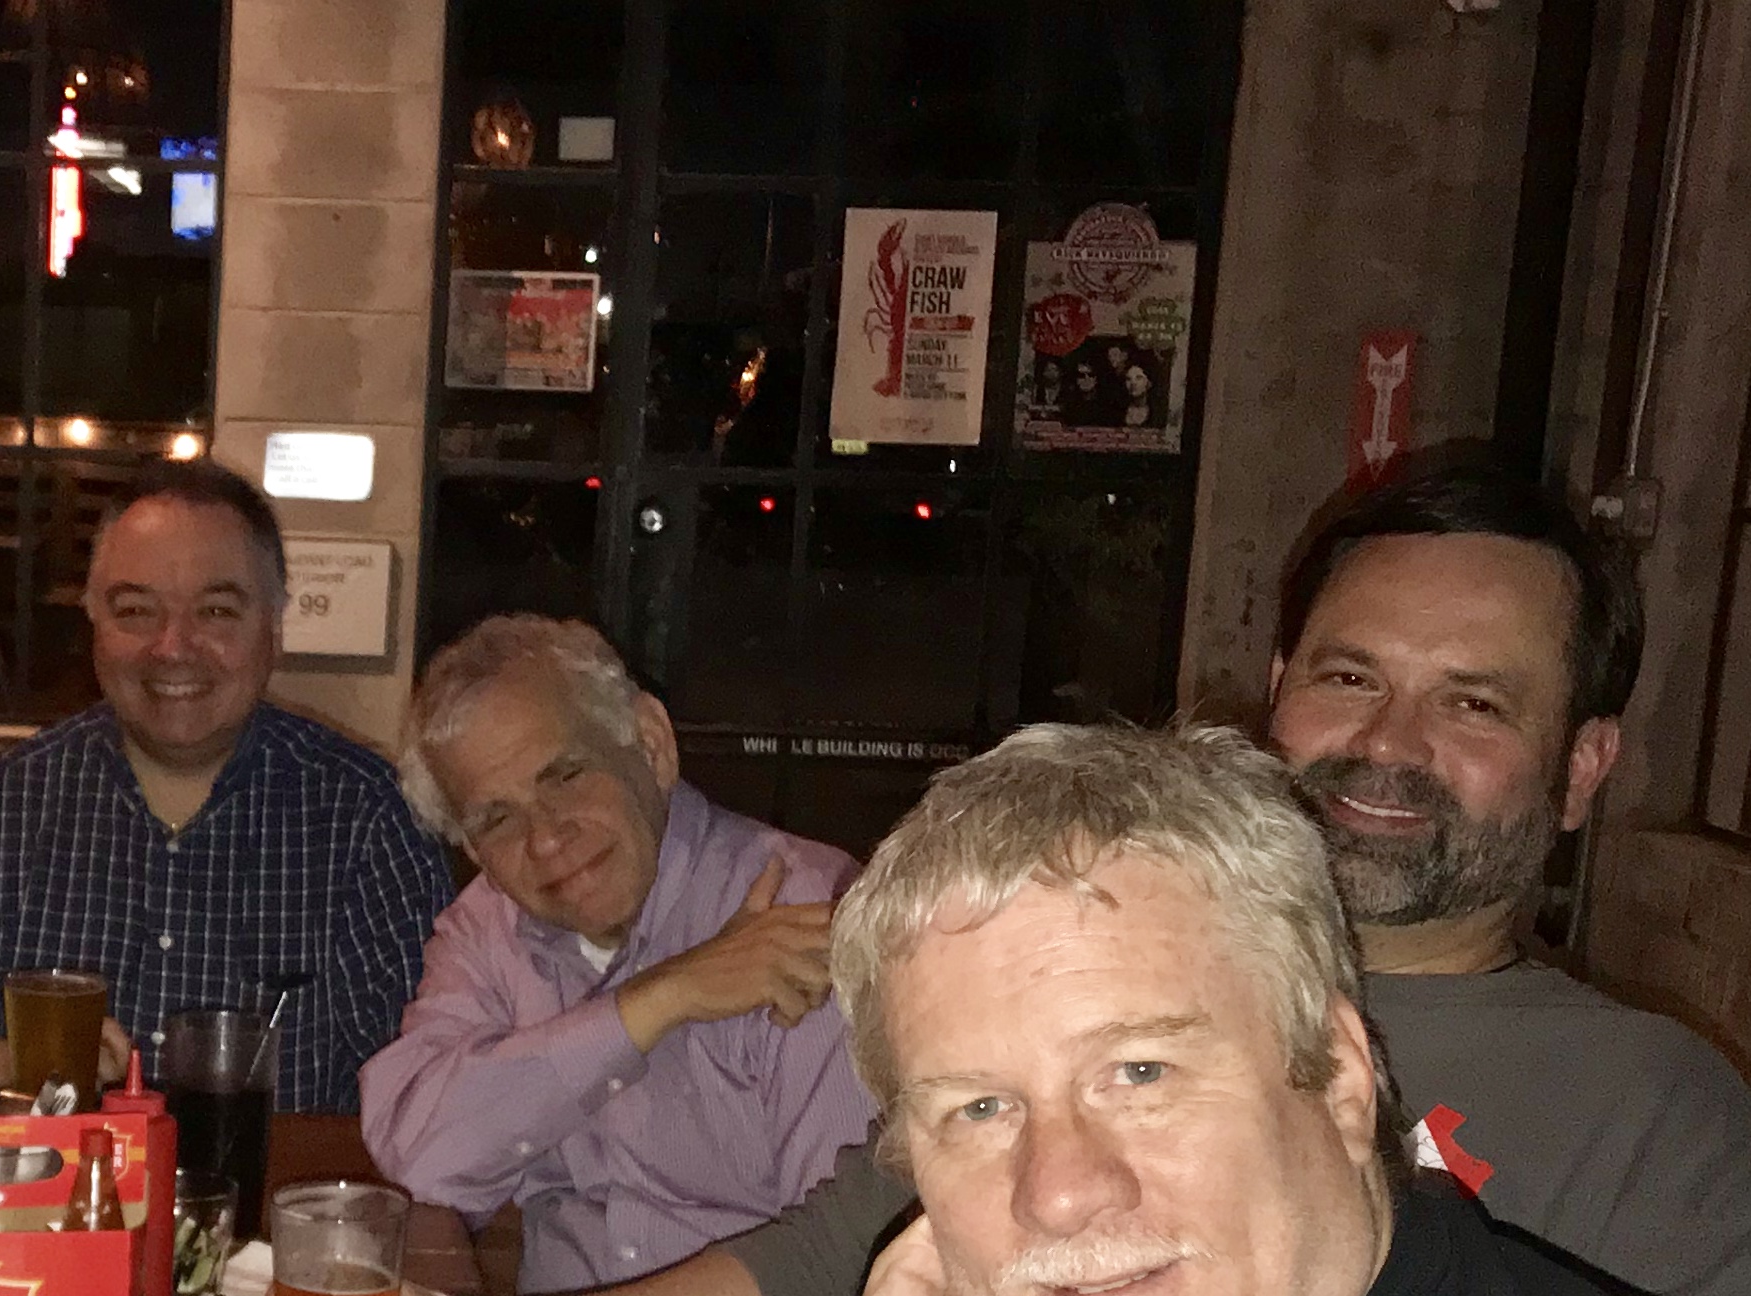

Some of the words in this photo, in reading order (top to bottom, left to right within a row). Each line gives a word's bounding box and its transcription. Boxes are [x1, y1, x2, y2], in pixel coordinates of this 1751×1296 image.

[912, 265, 967, 289] CRAW
[909, 291, 951, 314] FISH
[298, 594, 330, 617] 99
[816, 739, 903, 757] BUILDING
[907, 743, 925, 758] IS
